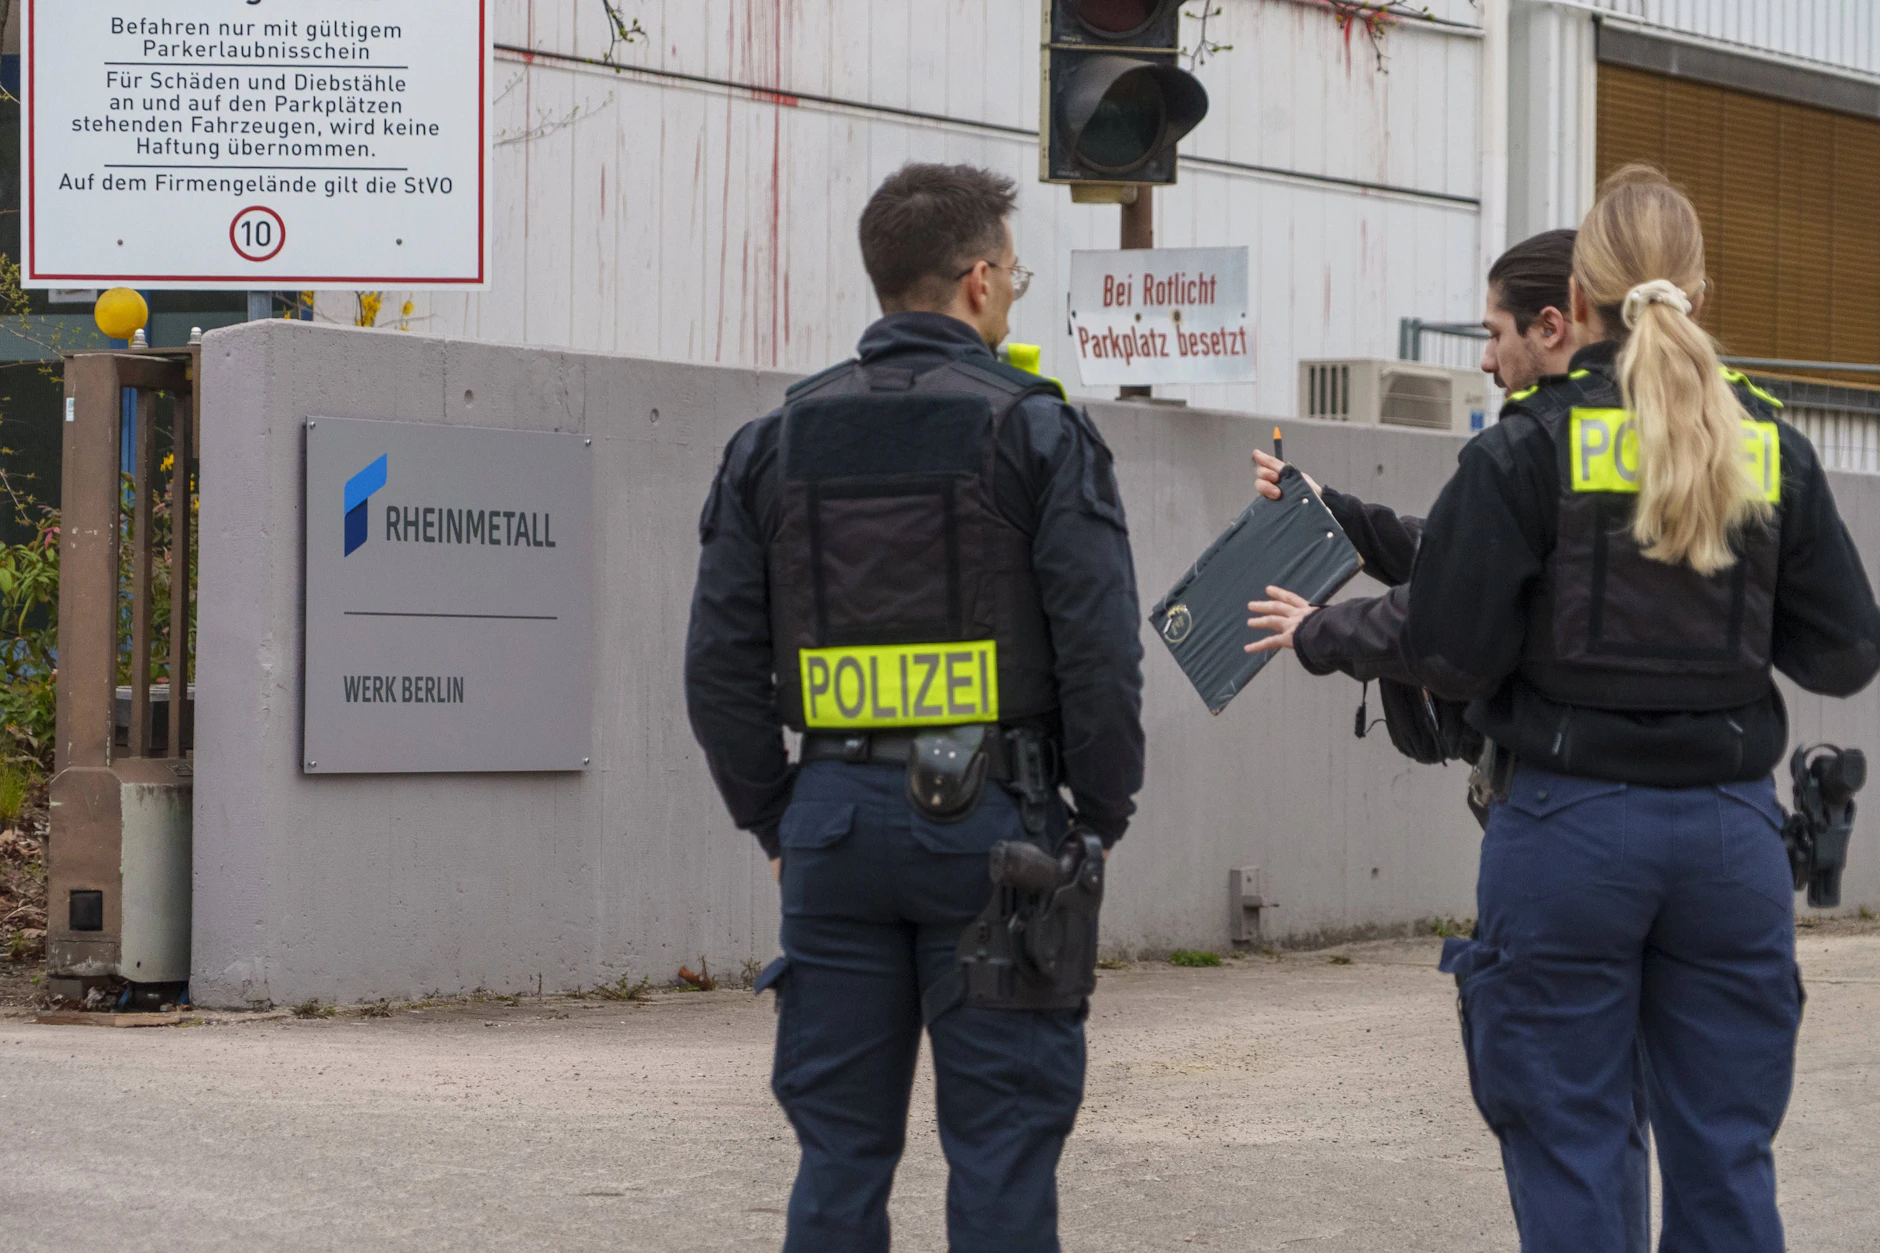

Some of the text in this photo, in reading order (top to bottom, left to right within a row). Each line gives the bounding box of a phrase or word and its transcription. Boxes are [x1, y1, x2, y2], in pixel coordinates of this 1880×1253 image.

[111, 17, 402, 40] Befahren nur mit gültigem
[143, 39, 370, 60] Parkerlaubnisschein
[106, 70, 406, 93] Für Schäden und Diebstähle
[109, 94, 402, 116] an und auf den Parkplätzen
[71, 115, 440, 137] stehenden Fahrzeugen, wird keine
[136, 137, 376, 159] Haftung übernommen.
[59, 173, 453, 197] Auf dem Firmengelände gilt die StVO
[240, 220, 271, 247] 10
[1103, 272, 1217, 307] Bei Rotlicht
[1078, 324, 1247, 366] Parkplatz besetzt
[386, 505, 556, 548] RHEINMETALL
[343, 675, 464, 704] WERK BERLIN
[807, 650, 990, 720] POLIZEI
